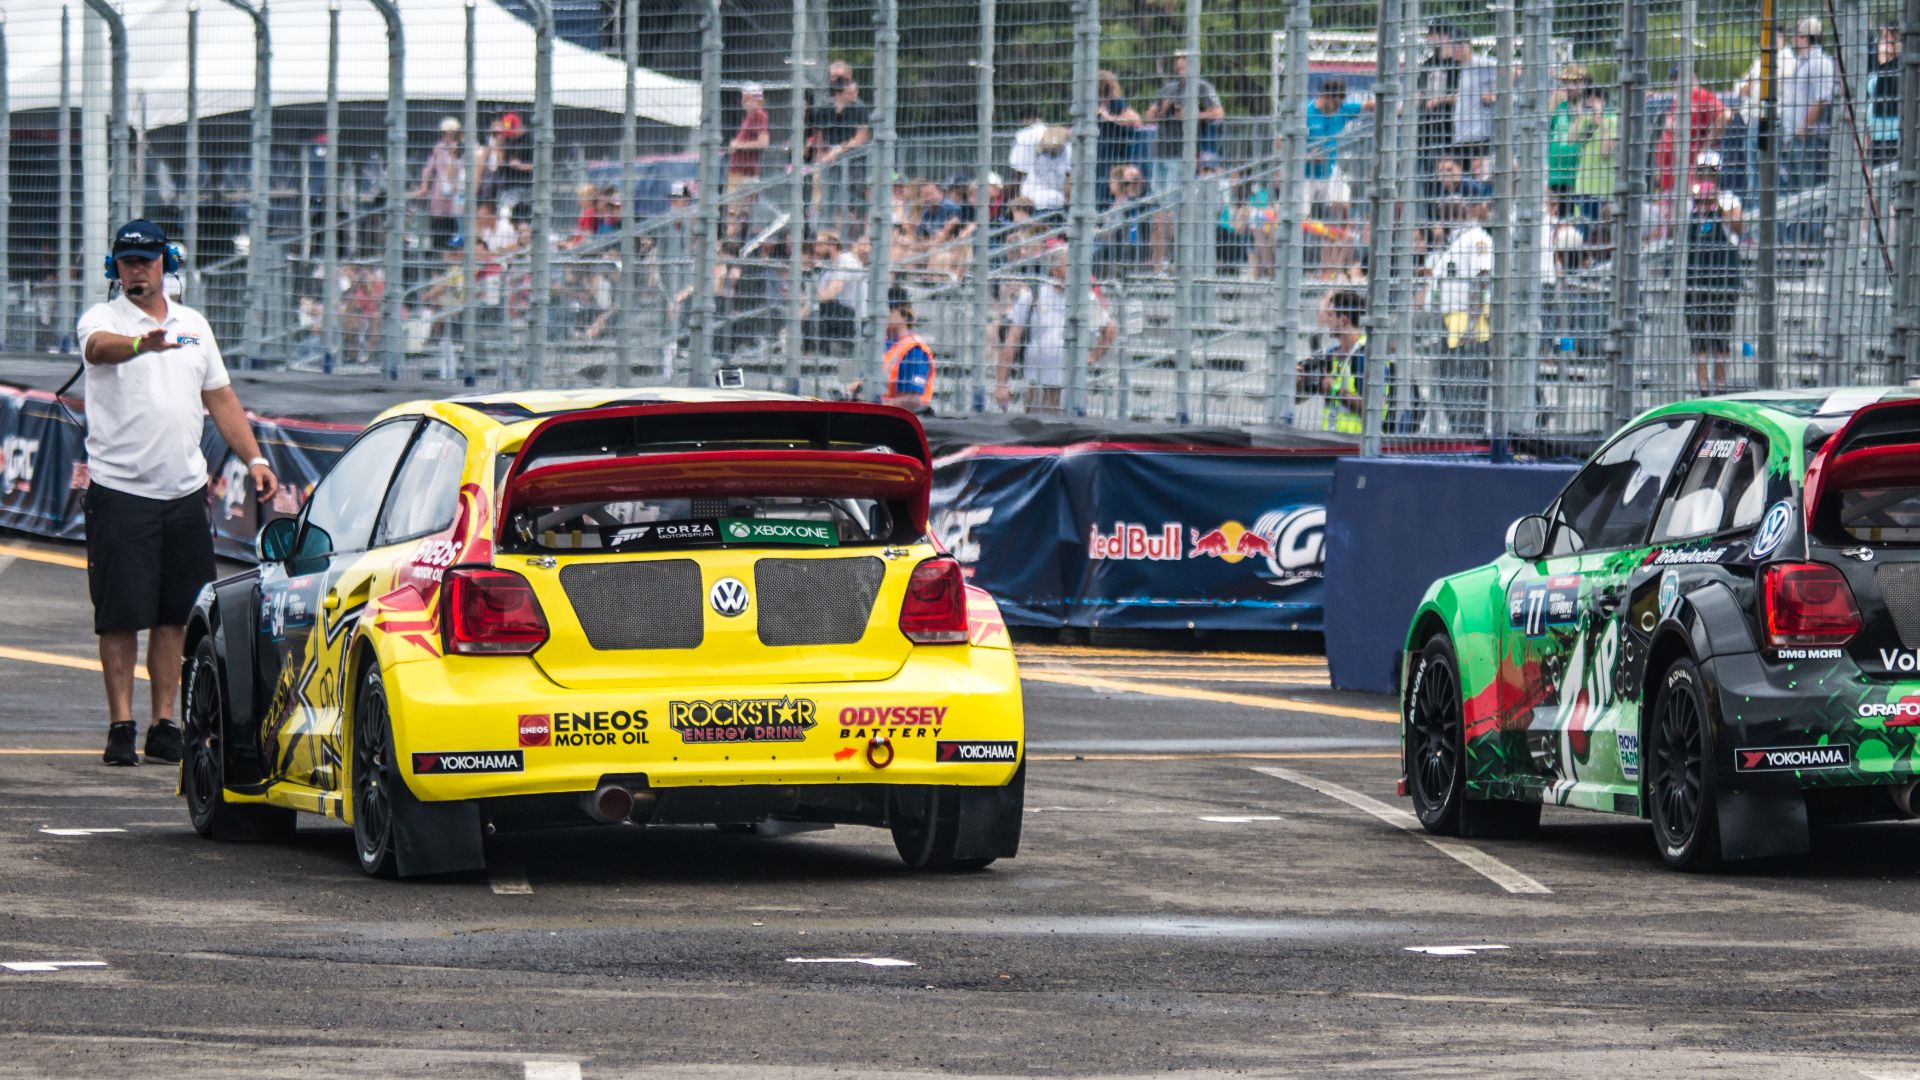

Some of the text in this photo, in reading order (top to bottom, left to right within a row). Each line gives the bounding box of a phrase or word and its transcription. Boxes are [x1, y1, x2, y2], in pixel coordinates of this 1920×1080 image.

[1709, 440, 1736, 457] SPEED
[657, 524, 713, 534] FORZA
[753, 525, 830, 539] XBOX ONE
[1126, 523, 1183, 561] Bull
[1526, 589, 1546, 635] 77
[1778, 649, 1842, 659] DMG MORI
[1410, 658, 1428, 725] ADVAN
[554, 710, 649, 732] ENEOS
[839, 706, 948, 726] ODYSSEY
[520, 726, 549, 734] ENEOS
[685, 726, 803, 740] ENERGY DRINK
[840, 728, 942, 738] BATTERY
[555, 731, 649, 746] MOTOR OIL
[959, 745, 1015, 759] YOKOHAMA
[1766, 751, 1844, 766] YOKOHAMA
[440, 754, 518, 770] YOKOHAMA
